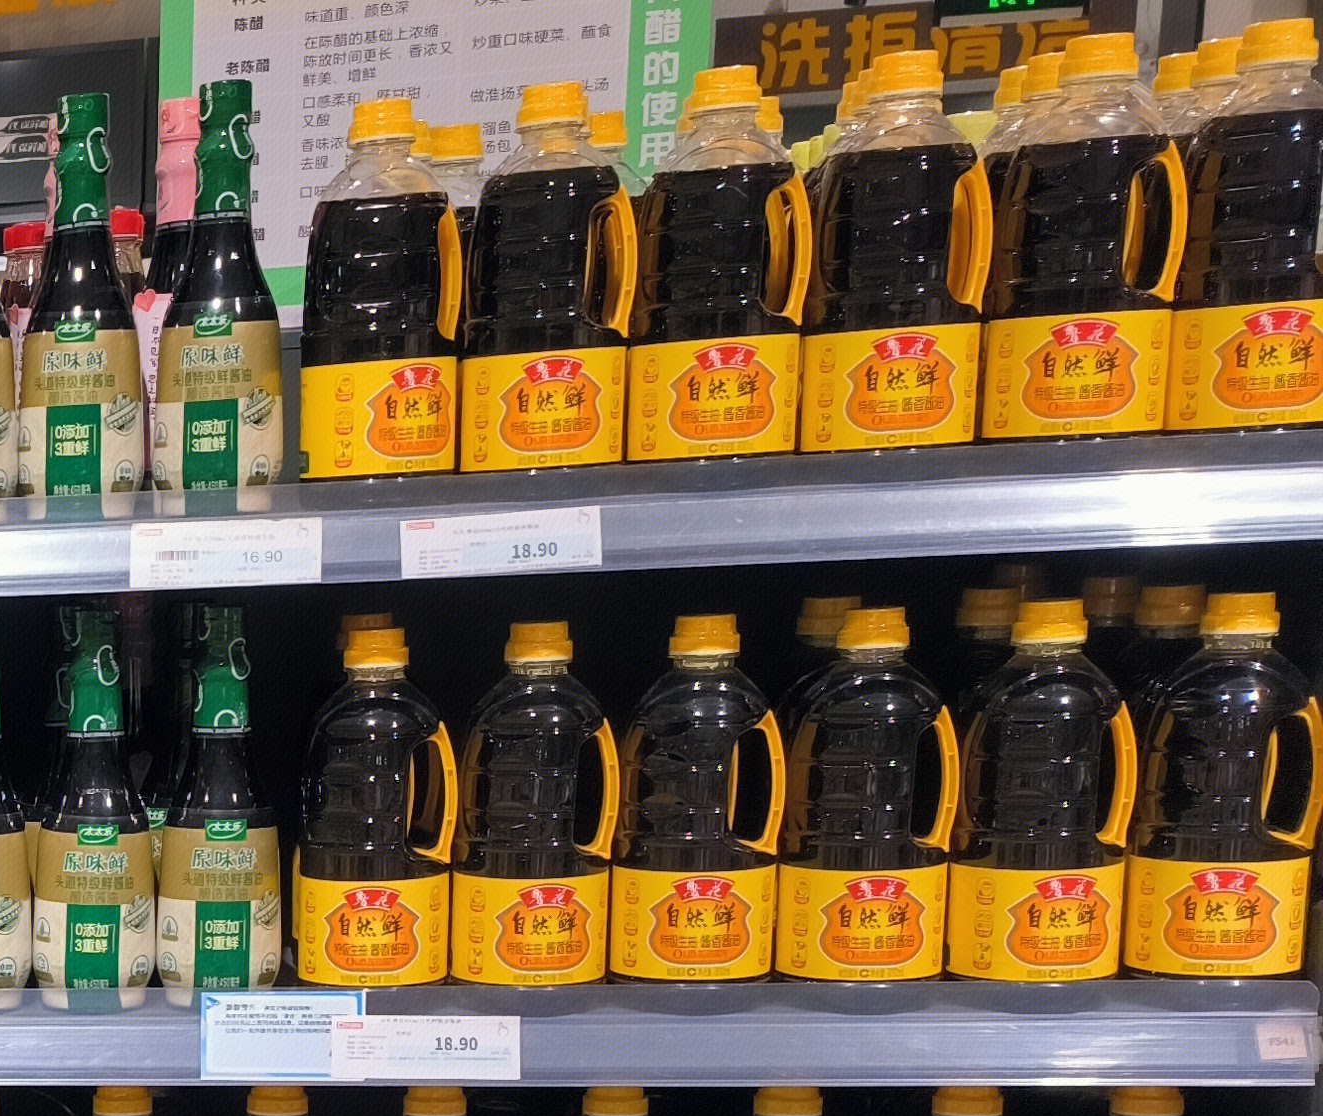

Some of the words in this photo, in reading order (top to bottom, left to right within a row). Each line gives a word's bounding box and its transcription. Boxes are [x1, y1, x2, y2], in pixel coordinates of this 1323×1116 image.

[233, 15, 264, 32] 陈醋
[304, 3, 411, 25] 味道重、颜色深
[225, 58, 271, 76] 老陈醋
[302, 67, 377, 87] 鲜美、增鲜
[301, 115, 331, 128] 又酸
[181, 345, 245, 368] 原味鲜
[1042, 348, 1120, 379] 自然鲜
[686, 371, 761, 403] 自然鲜
[864, 361, 940, 393] 自然鲜
[384, 392, 444, 421] 自然鲜
[515, 383, 587, 414] 自然鲜
[241, 550, 284, 564] 16.90
[511, 542, 559, 559] 18.90
[191, 848, 258, 871] 原味鲜
[182, 872, 263, 889] 头道特级鲜酱油
[666, 901, 738, 930] 自然鲜
[837, 901, 909, 930] 自然鲜
[1182, 895, 1262, 924] 自然鲜
[204, 919, 245, 935] 0添加
[338, 912, 404, 939] 自然鲜
[434, 1036, 479, 1052] 18.90
